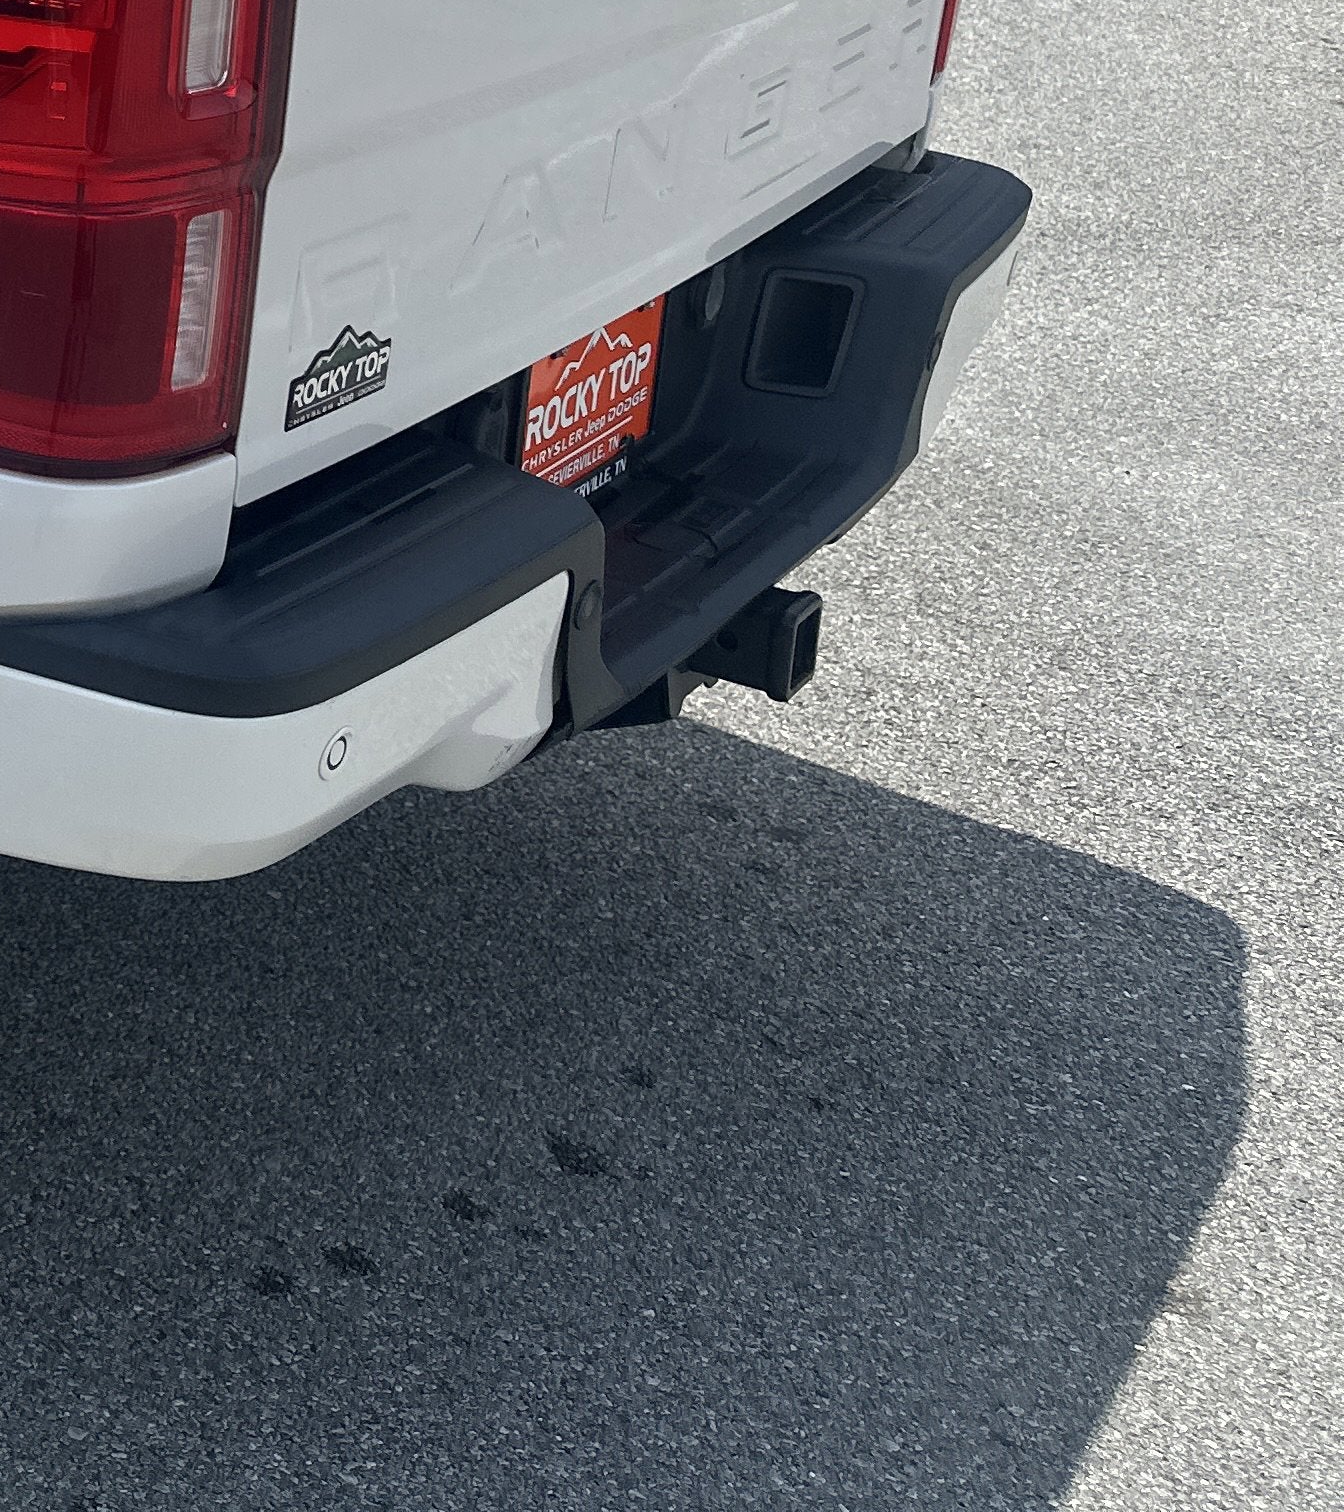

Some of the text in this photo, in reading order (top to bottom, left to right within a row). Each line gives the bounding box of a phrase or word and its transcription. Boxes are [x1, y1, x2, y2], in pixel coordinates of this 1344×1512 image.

[293, 345, 391, 408] ROCKY TOP
[524, 341, 652, 452] ROCKY TOP
[521, 386, 648, 472] CHRYSLER Jeep DODGE
[614, 455, 628, 477] TN
